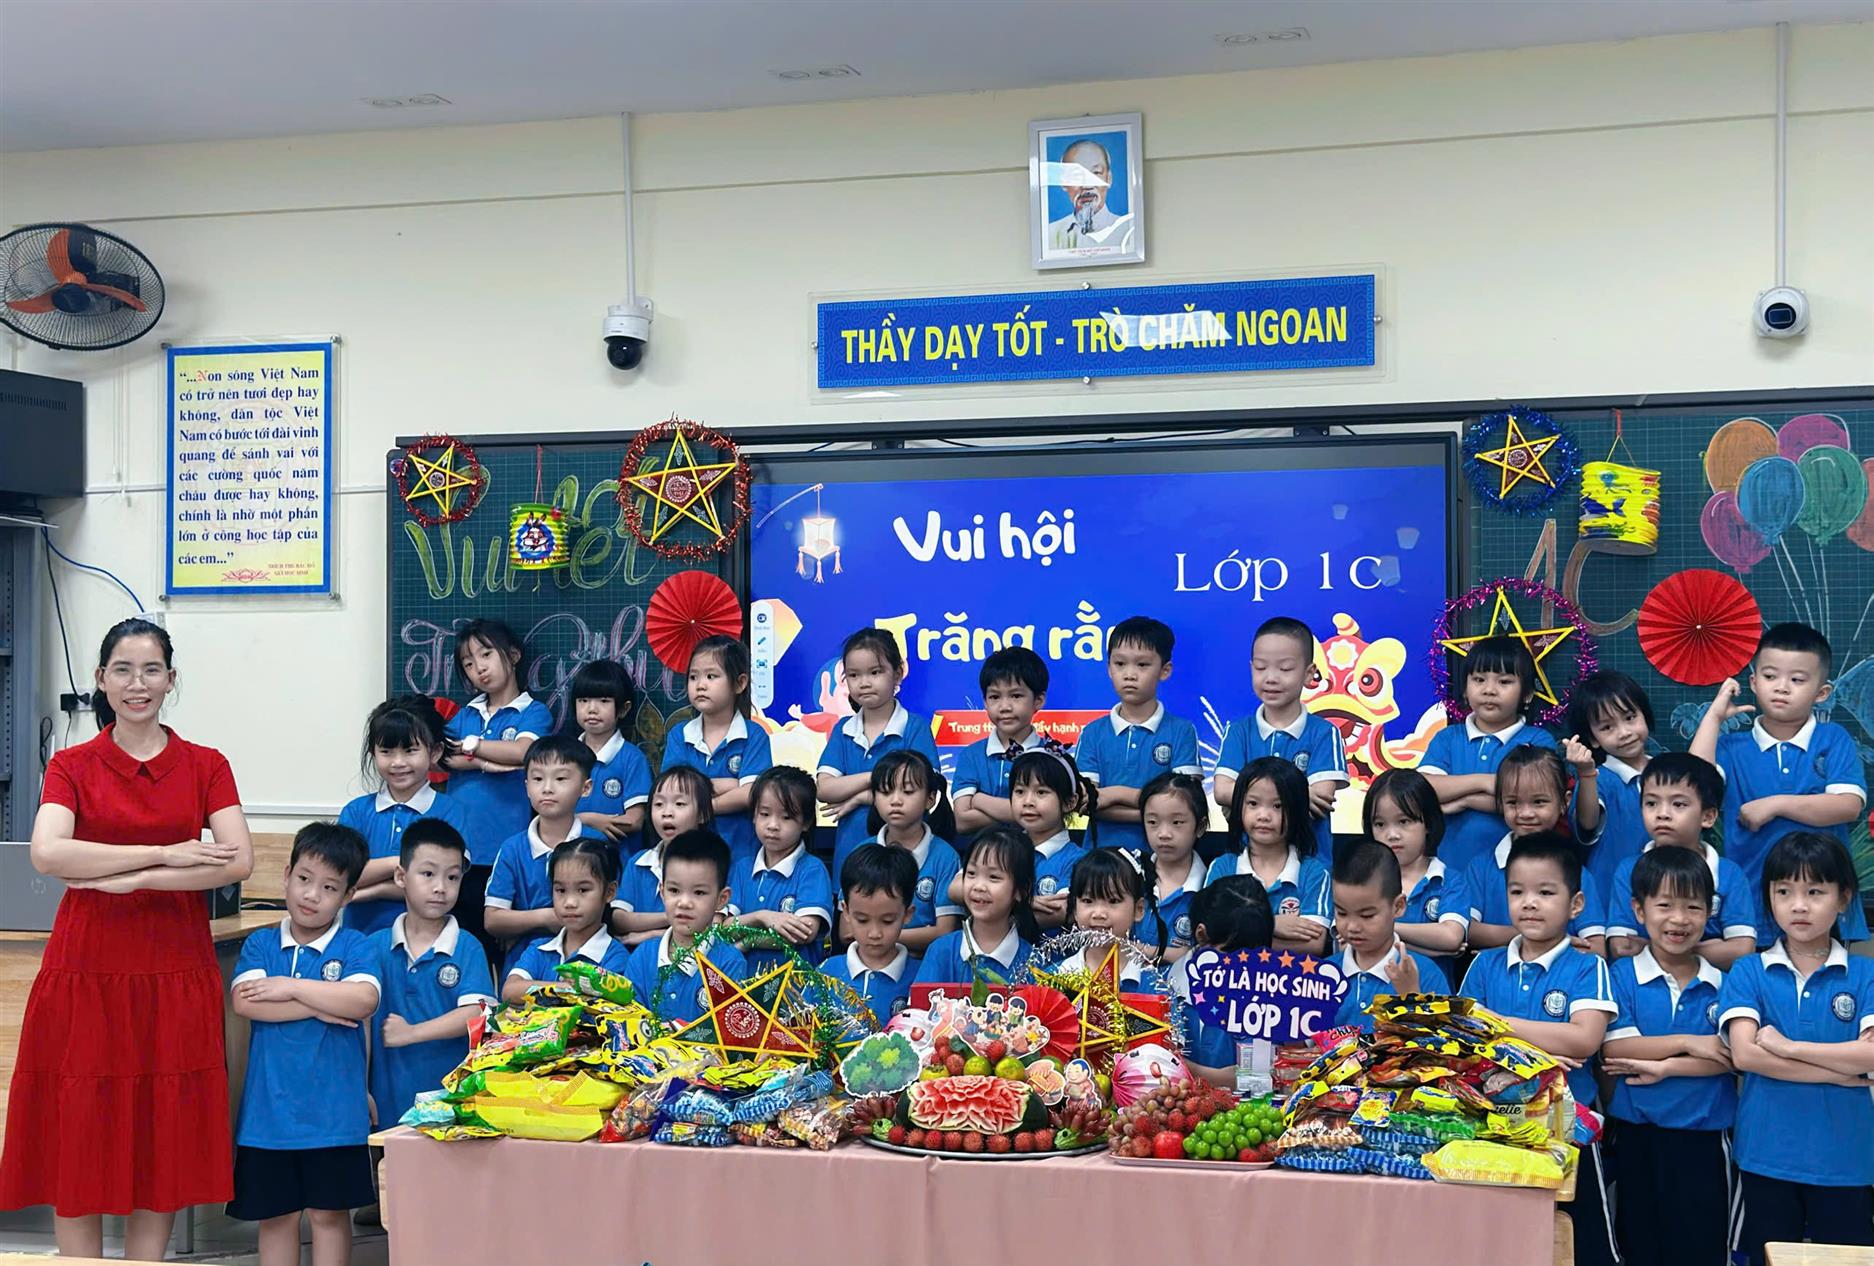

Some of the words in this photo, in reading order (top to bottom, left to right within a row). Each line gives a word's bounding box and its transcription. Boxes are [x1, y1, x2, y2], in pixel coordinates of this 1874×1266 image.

[841, 313, 915, 364] THẦY
[925, 324, 984, 370] DẠY
[993, 305, 1047, 357] TỐT
[1072, 307, 1129, 353] TRÒ
[1139, 304, 1226, 350] CHĂM
[1237, 306, 1347, 347] NGOAN
[261, 368, 284, 383] Việt
[291, 367, 319, 379] Nam
[180, 389, 193, 401] có
[244, 387, 267, 399] tươi
[271, 387, 293, 400] đẹp
[297, 386, 319, 399] hay
[294, 405, 318, 420] Việt
[180, 429, 206, 441] Nam
[209, 429, 222, 440] có
[225, 429, 252, 440] bước
[255, 428, 270, 439] tới
[272, 427, 290, 439] đài
[293, 426, 318, 438] vinh
[180, 451, 215, 463] quang
[242, 448, 269, 459] sánh
[277, 448, 294, 458] vai
[301, 447, 319, 458] với
[179, 470, 198, 481] các
[208, 469, 243, 481] cường
[253, 466, 282, 481] quốc
[214, 489, 242, 502] được
[249, 488, 270, 502] hay
[179, 510, 211, 521] chính
[217, 509, 226, 520] là
[232, 509, 255, 520] nhờ
[260, 510, 282, 522] một
[178, 530, 196, 541] lớn
[247, 529, 267, 543] học
[297, 527, 318, 539] của
[893, 510, 985, 562] Vui
[1000, 509, 1076, 566] hội
[178, 553, 197, 564] các
[1174, 549, 1289, 601] Lớp
[1049, 600, 1115, 662] rằ
[948, 722, 980, 733] Trung
[1053, 722, 1079, 735] hạnh
[1203, 966, 1226, 987] TỚ
[1229, 967, 1250, 990] LÀ
[1255, 972, 1288, 997] HỌC
[1292, 977, 1330, 1000] SINH
[1227, 996, 1281, 1038] LỚP
[1290, 1007, 1321, 1038] 1C
